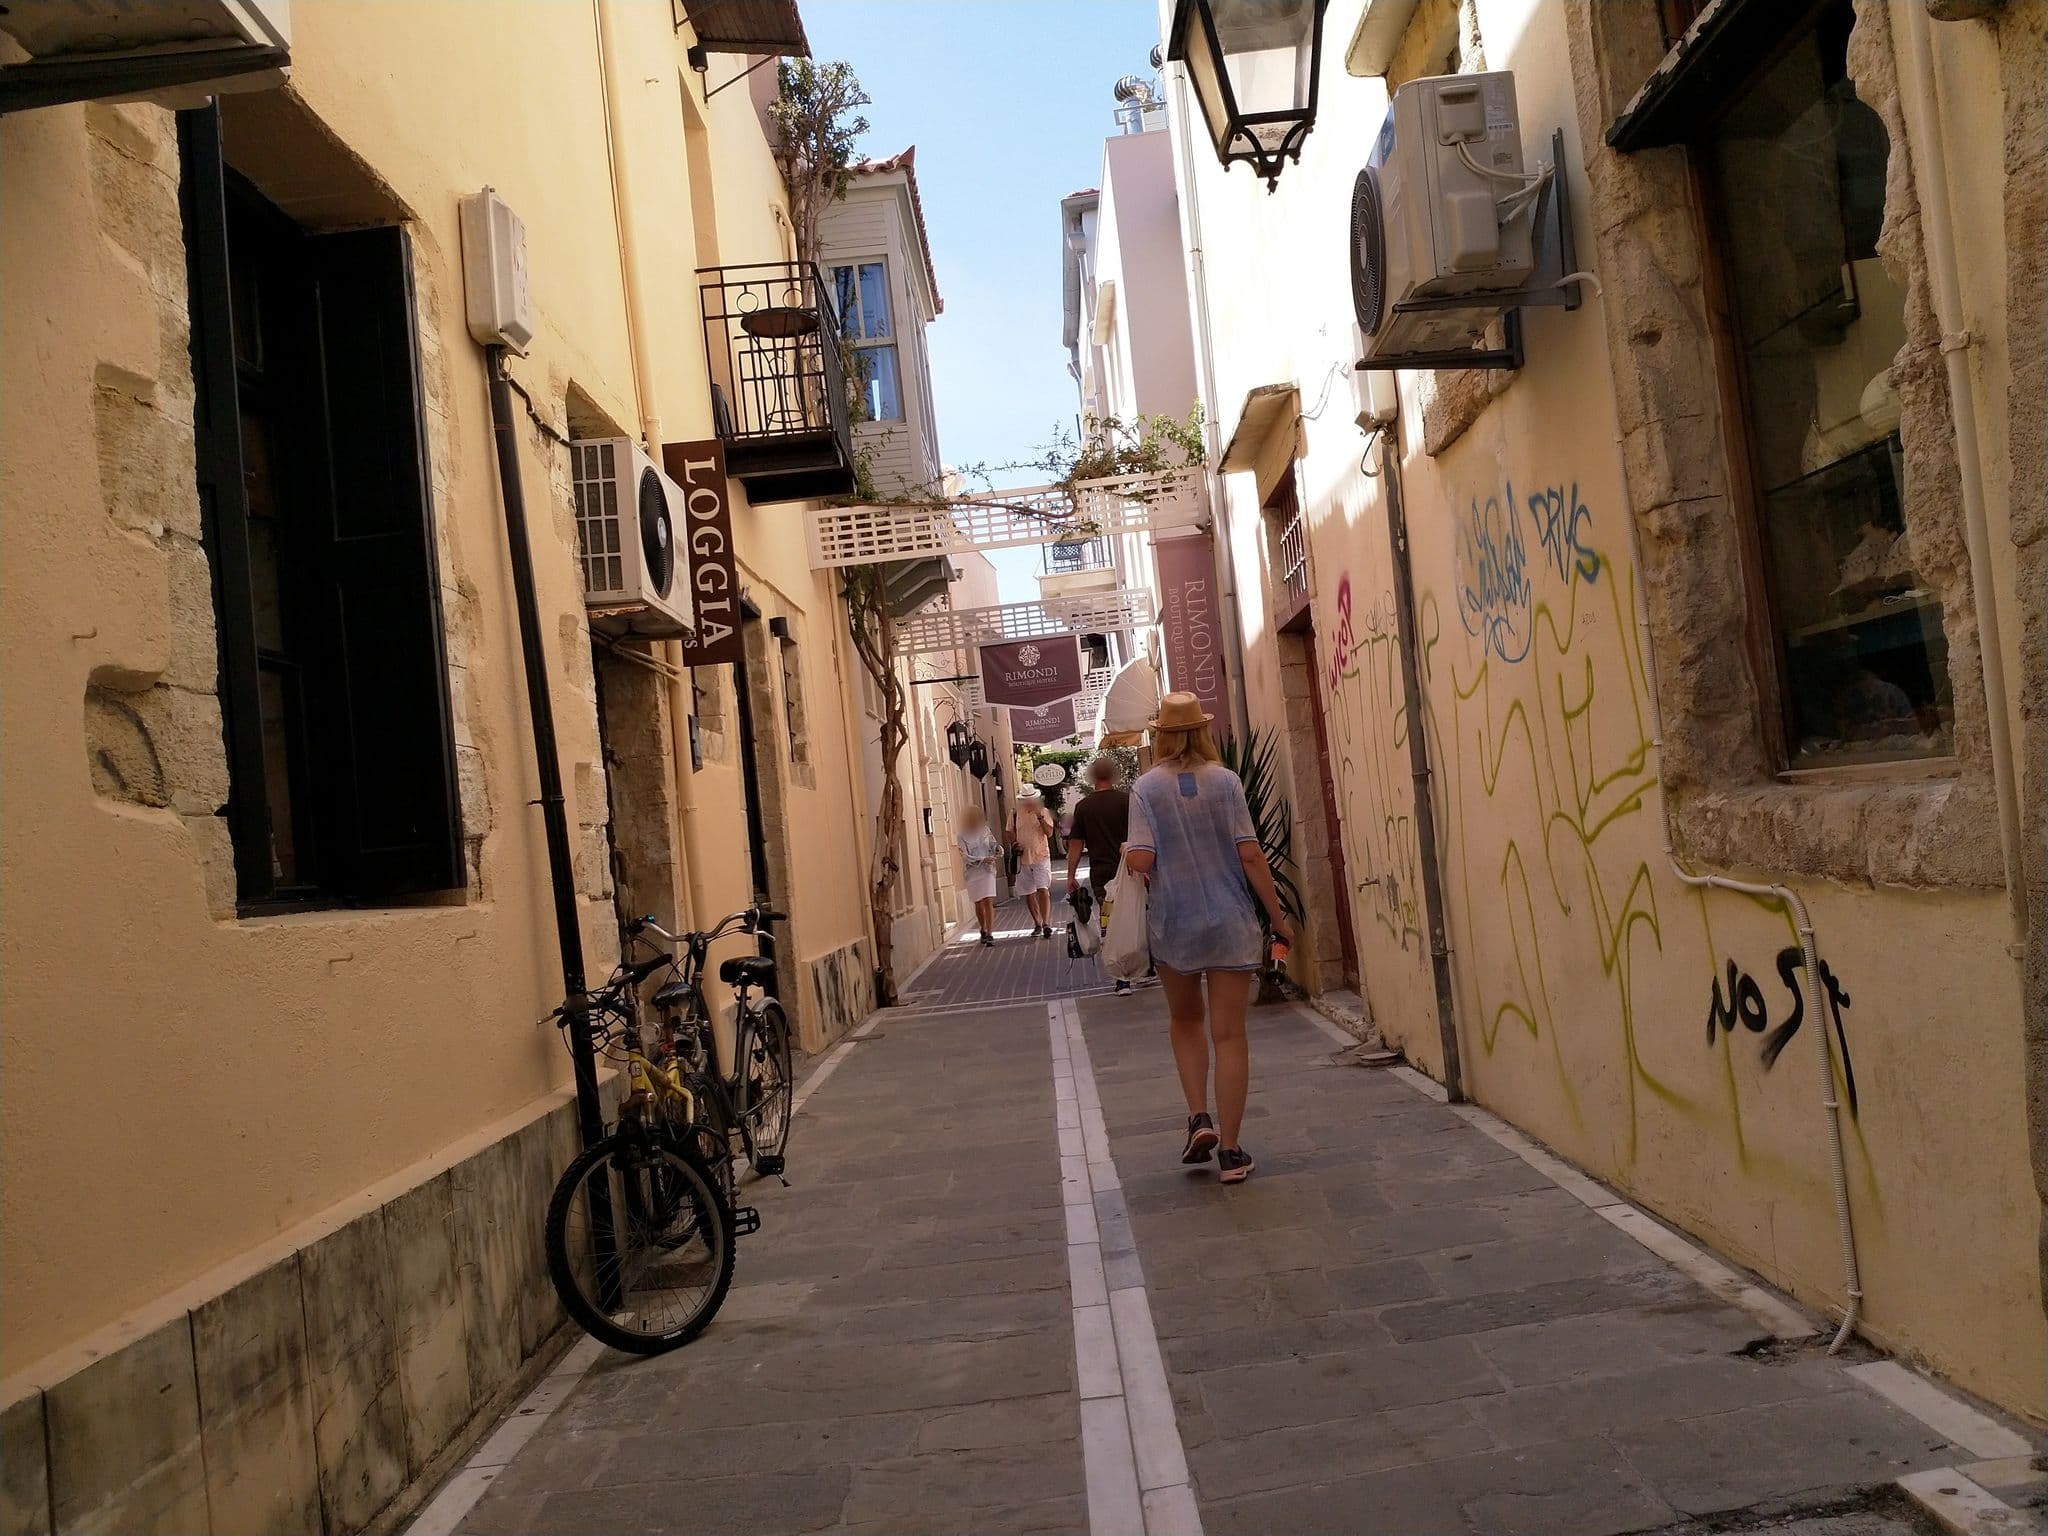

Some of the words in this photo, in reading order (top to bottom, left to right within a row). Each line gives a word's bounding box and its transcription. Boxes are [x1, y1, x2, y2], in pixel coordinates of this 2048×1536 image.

[684, 456, 733, 648] LOGGIA
[1005, 666, 1058, 682] RIMONDI
[1168, 587, 1184, 653] BOUTIQUE
[1176, 655, 1189, 689] HOTE
[1185, 577, 1218, 702] RIMONDI
[1025, 716, 1061, 728] RIMONDI
